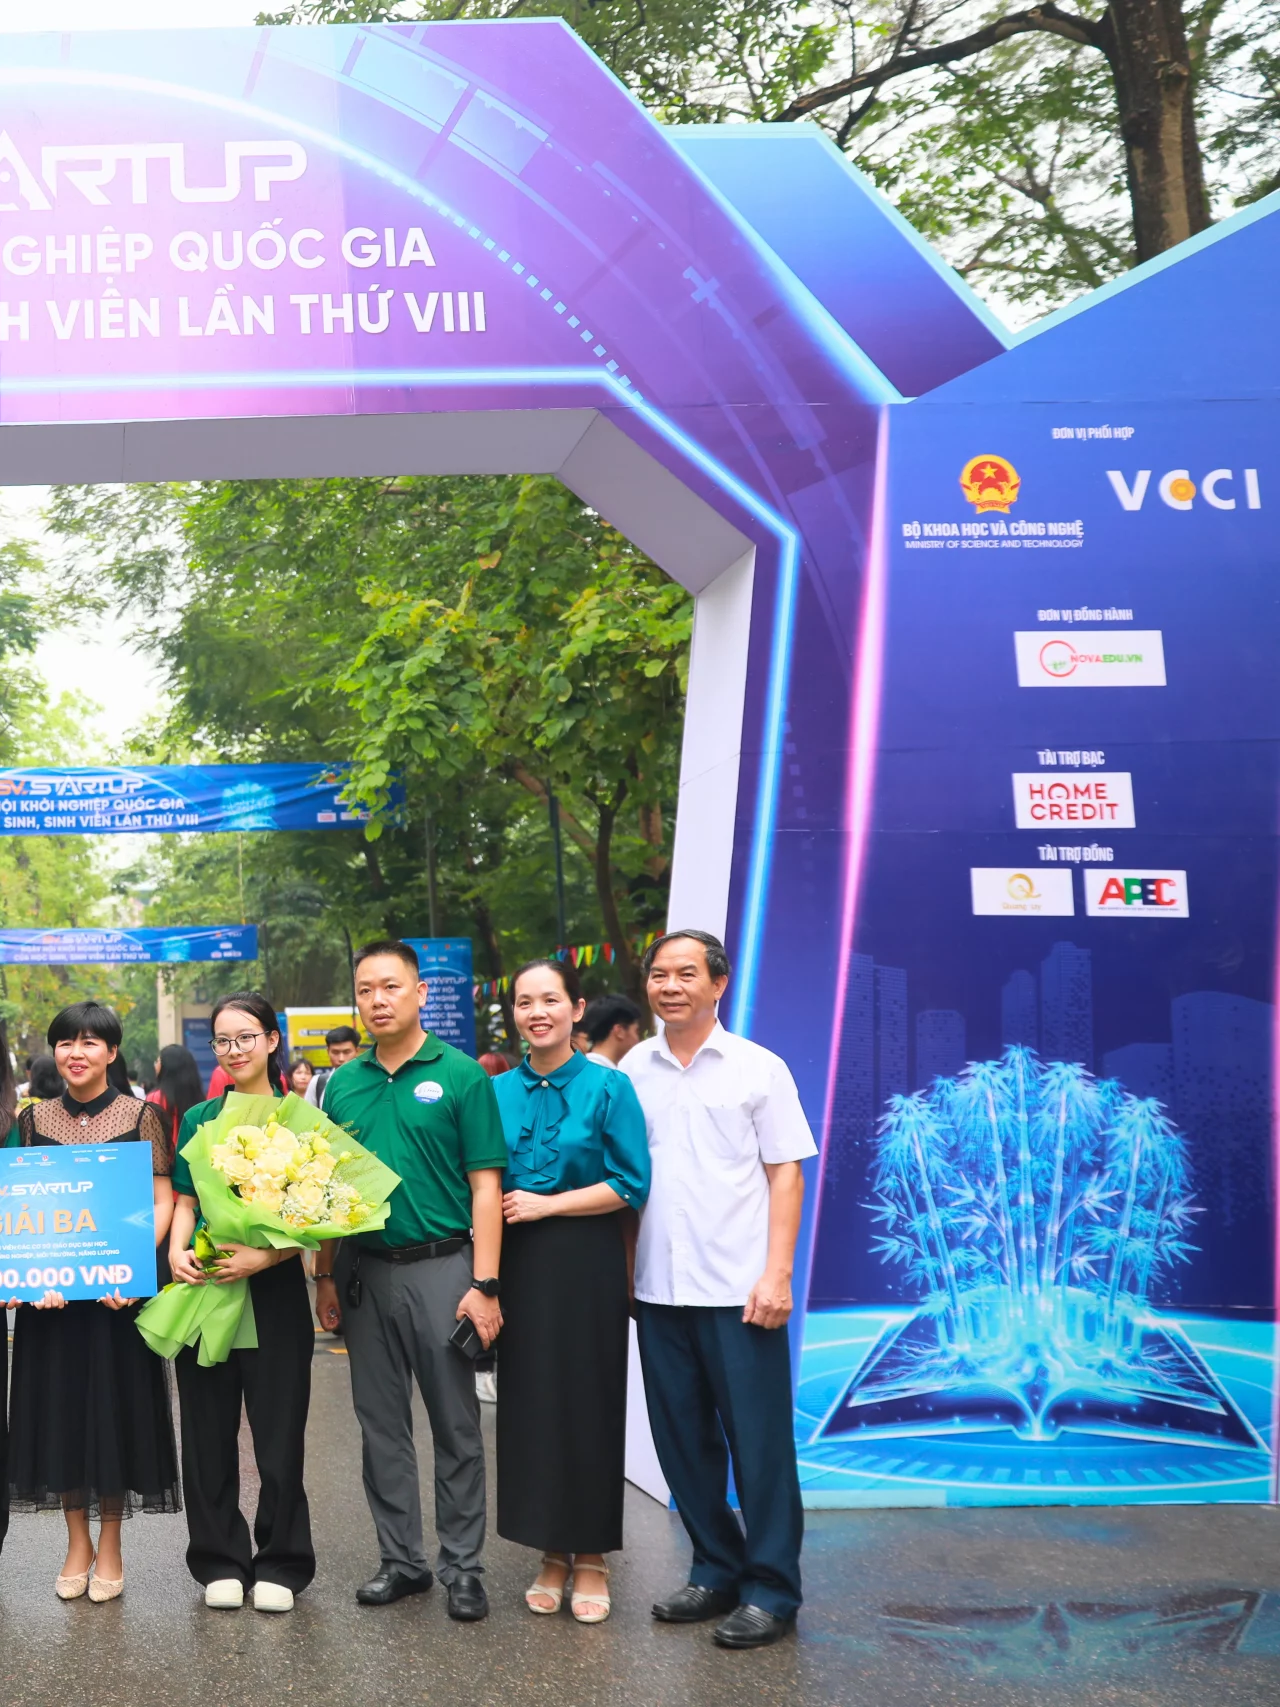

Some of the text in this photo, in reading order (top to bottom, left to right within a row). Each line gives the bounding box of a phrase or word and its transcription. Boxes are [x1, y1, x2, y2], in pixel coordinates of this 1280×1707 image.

[169, 218, 326, 273] QUỐC
[341, 227, 436, 268] GIA
[46, 288, 160, 340] VIÊN
[178, 283, 275, 336] LẦN
[290, 284, 395, 334] THỨ
[403, 291, 487, 333] VIII
[1052, 424, 1135, 441] ĐƠN VỊ PHỐI HỢP
[1105, 469, 1261, 511] VCCI
[902, 519, 1084, 539] BỘ KHOA HỌC VÀ CÔNG NGHỆ
[905, 539, 1084, 549] MINISTRY OF SCIENCE AND TECHNOLOGY
[1037, 608, 1060, 621] ĐƠN
[1061, 609, 1073, 623] VỊ
[1103, 606, 1133, 620] HÀNH
[1070, 654, 1143, 663] NOVAEDU.VN
[1037, 749, 1105, 767] TÀI TRỢ BẠC
[1029, 782, 1108, 800] HOME
[20, 796, 55, 811] KHỞI
[58, 799, 109, 813] NGHIỆP
[112, 796, 156, 811] QUỐC
[160, 798, 185, 810] GIA
[1030, 803, 1119, 820] CREDIT
[4, 816, 40, 830] SINH,
[44, 816, 76, 828] SINH
[79, 813, 112, 827] VIÊN
[145, 812, 174, 827] THỨ
[176, 813, 199, 825] VIII
[1038, 843, 1114, 863] TÀI TRỢ ĐỒNG
[1098, 878, 1178, 906] APEC
[54, 1208, 97, 1233] BA
[79, 1264, 133, 1285] VNĐ
